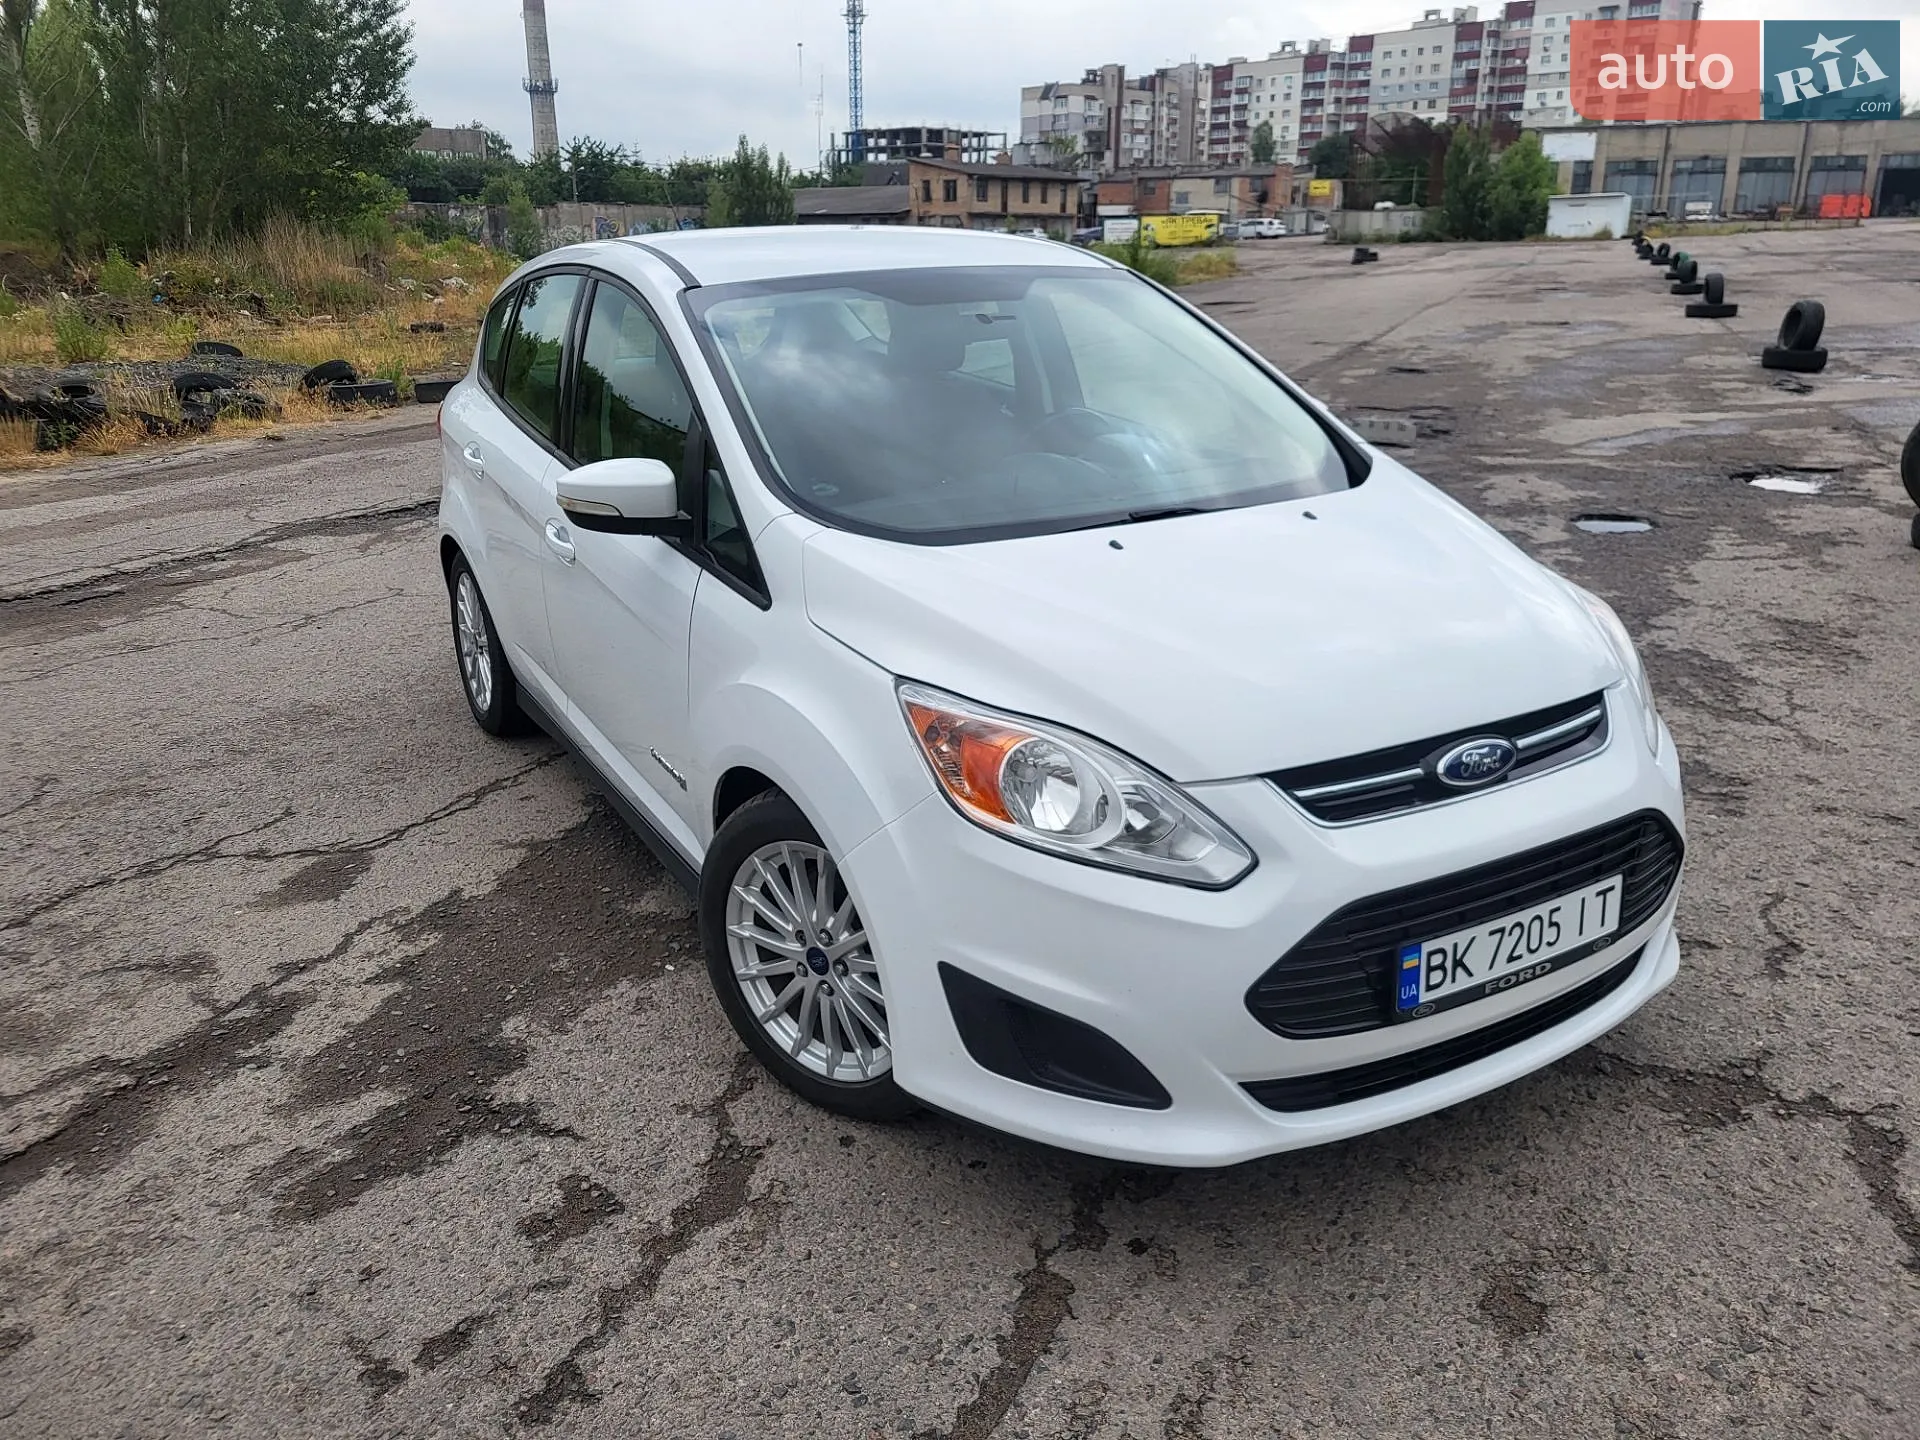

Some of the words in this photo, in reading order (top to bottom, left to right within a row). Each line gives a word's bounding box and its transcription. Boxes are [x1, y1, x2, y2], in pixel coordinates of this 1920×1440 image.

[1460, 746, 1501, 777] Ford
[1424, 935, 1478, 993] BK
[1487, 905, 1562, 971] 7205
[1401, 983, 1418, 1000] UA
[1484, 962, 1552, 995] FORD
